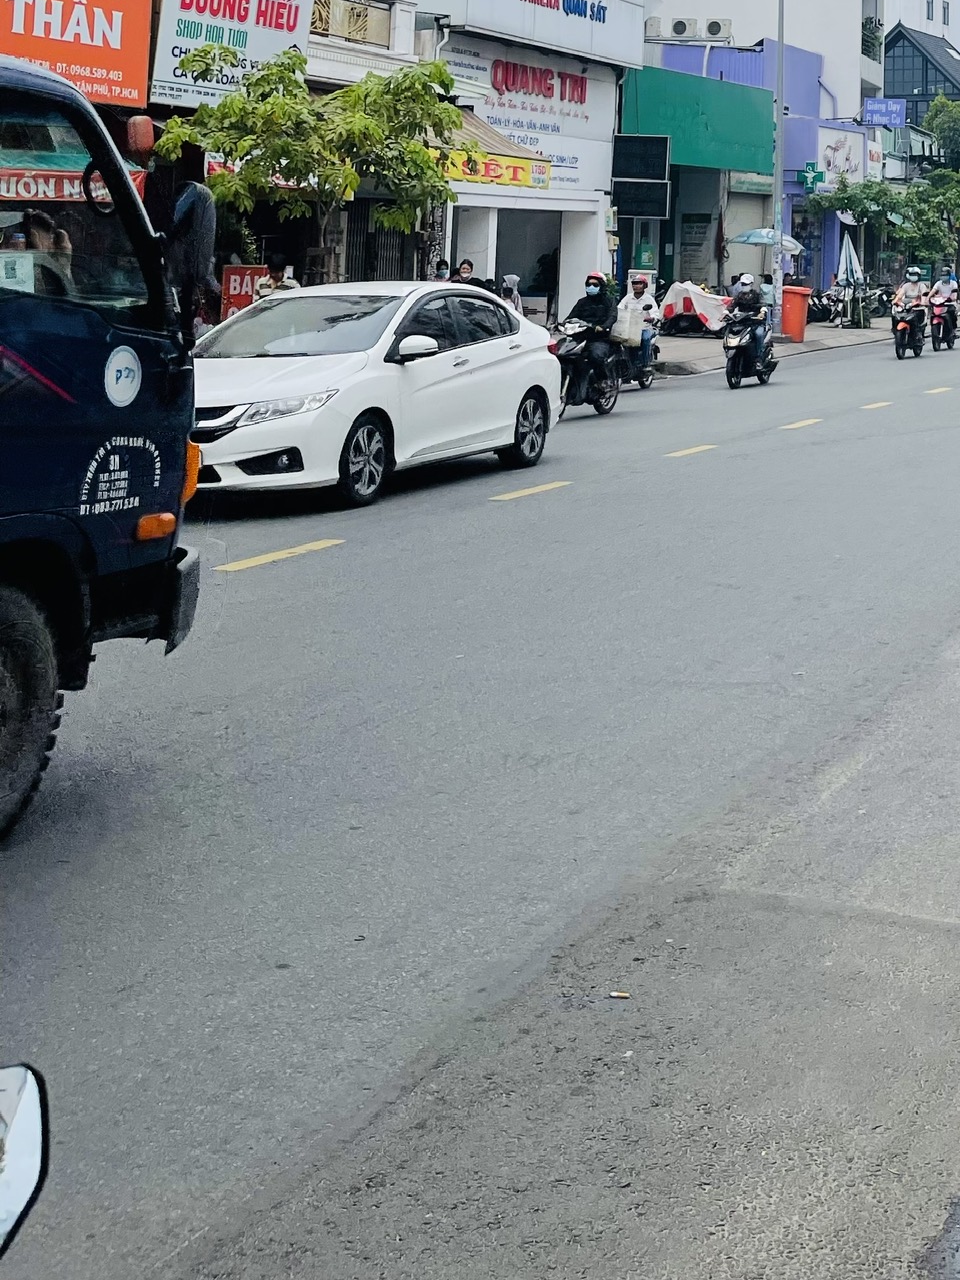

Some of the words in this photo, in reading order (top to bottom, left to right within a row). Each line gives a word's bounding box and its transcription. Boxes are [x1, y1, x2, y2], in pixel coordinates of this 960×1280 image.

[589, 0, 608, 24] SÁT
[176, 18, 203, 40] SHOP
[205, 24, 224, 45] HOA
[490, 59, 555, 99] QUANG
[558, 67, 588, 105] TRÍ
